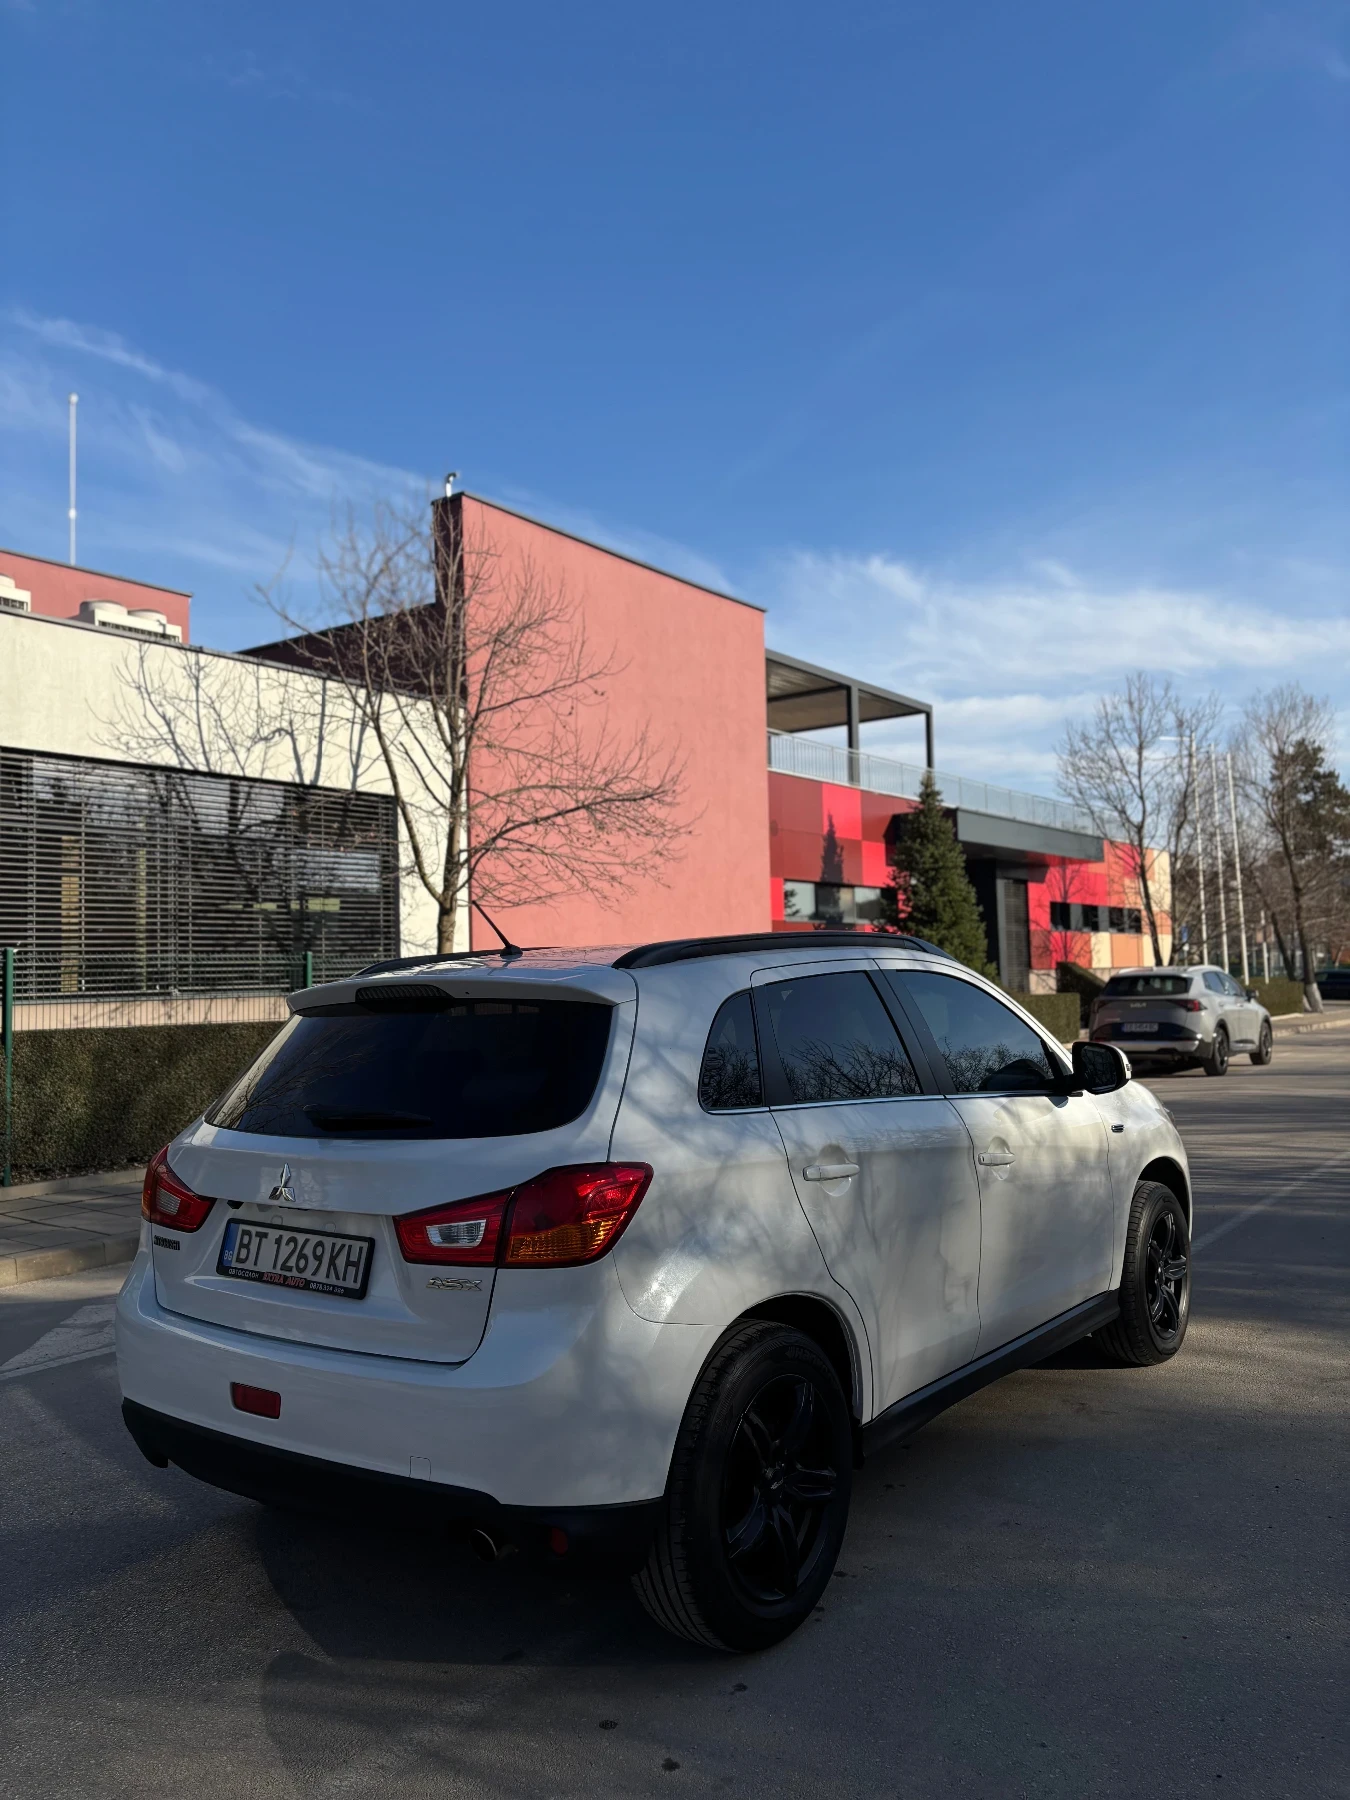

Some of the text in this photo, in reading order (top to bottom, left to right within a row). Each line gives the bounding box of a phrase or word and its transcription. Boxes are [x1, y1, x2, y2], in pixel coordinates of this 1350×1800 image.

[235, 1229, 269, 1267] BT
[262, 1271, 306, 1288] EXTRA AUTO
[425, 1276, 483, 1291] ASX
